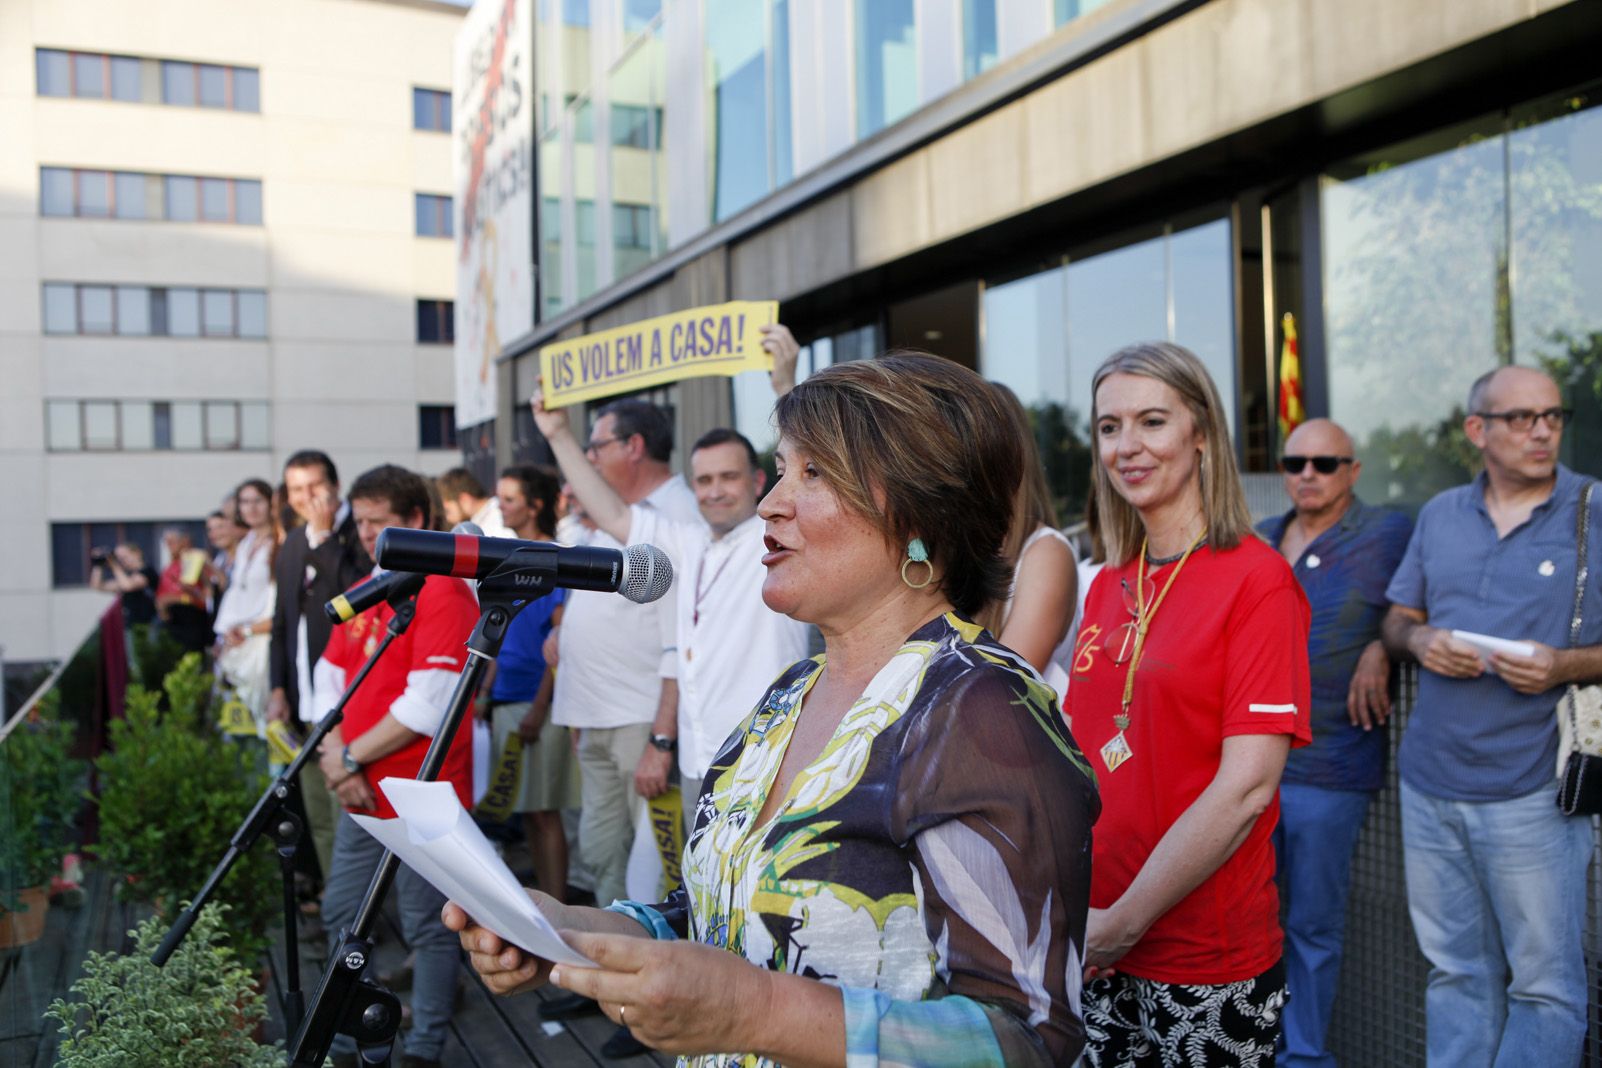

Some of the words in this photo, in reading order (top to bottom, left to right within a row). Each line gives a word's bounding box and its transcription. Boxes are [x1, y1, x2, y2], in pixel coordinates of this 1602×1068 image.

[551, 352, 574, 389] US
[579, 333, 643, 383] VOLEM
[650, 328, 663, 368] A
[670, 314, 745, 362] CASA!
[651, 806, 684, 882] CASA!
